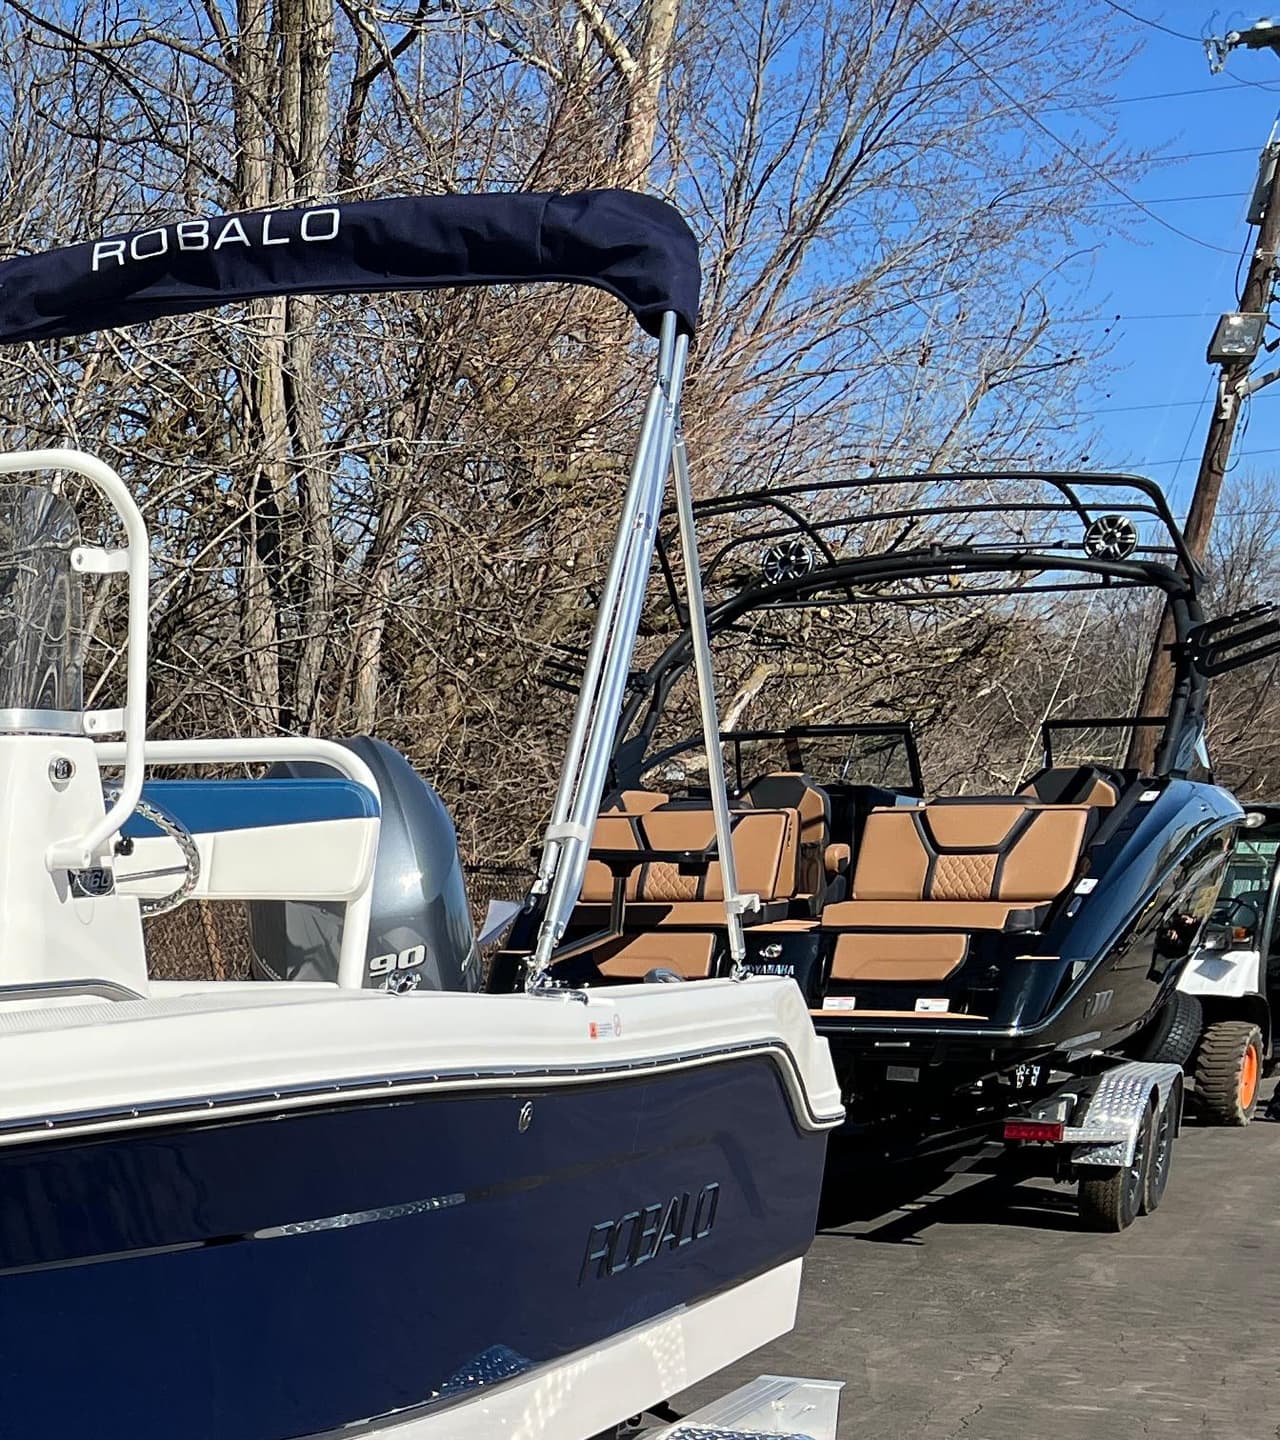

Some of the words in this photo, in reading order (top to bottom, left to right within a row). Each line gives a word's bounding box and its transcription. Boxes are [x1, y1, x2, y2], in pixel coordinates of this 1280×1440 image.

[91, 208, 341, 272] ROBALO
[368, 944, 426, 977] 90
[754, 964, 795, 975] YAMAHA
[576, 1181, 719, 1288] ROBALO
